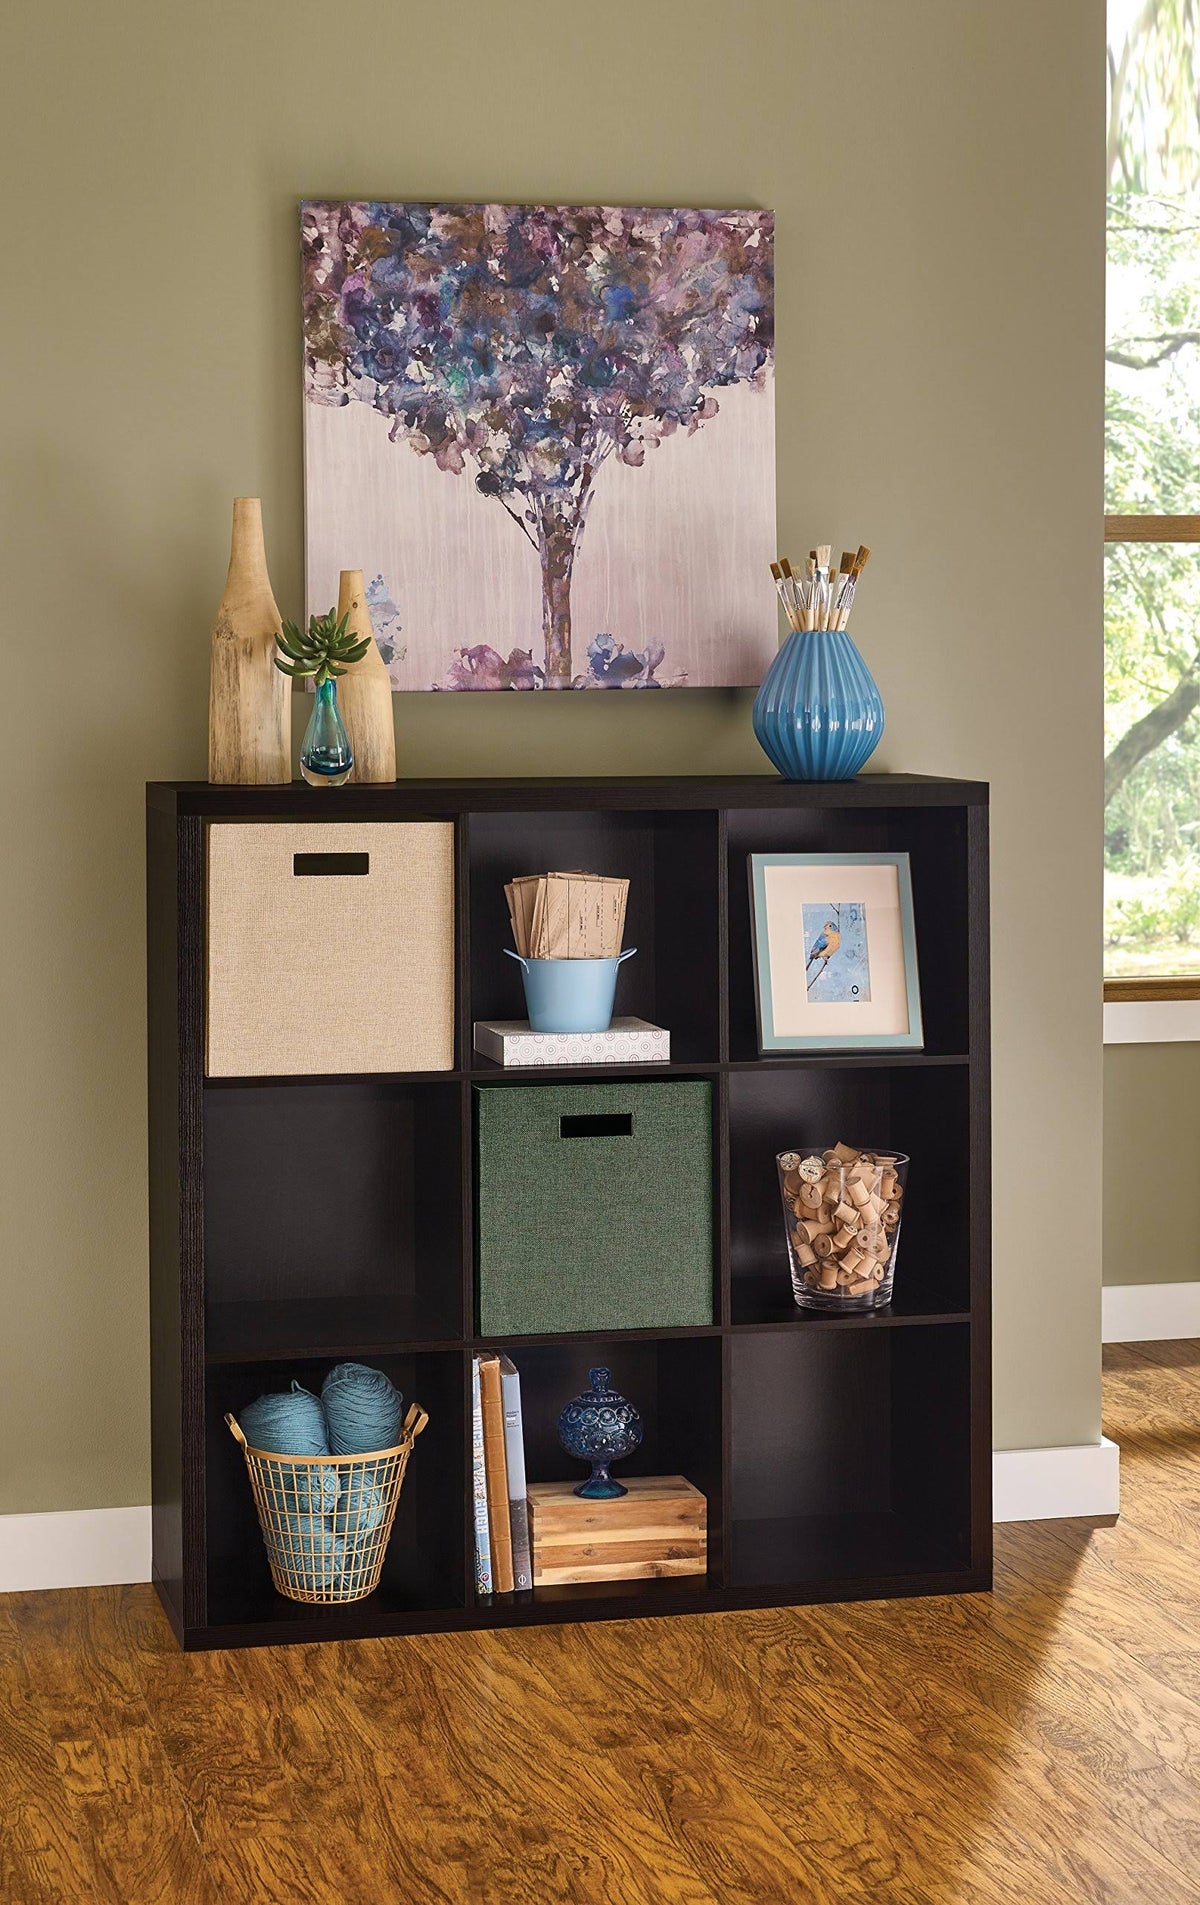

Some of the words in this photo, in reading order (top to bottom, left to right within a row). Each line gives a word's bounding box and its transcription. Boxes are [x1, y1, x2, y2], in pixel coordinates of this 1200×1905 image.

[473, 1408, 485, 1463] VINCENT
[474, 1468, 486, 1497] VAN
[476, 1500, 488, 1534] GOGH
